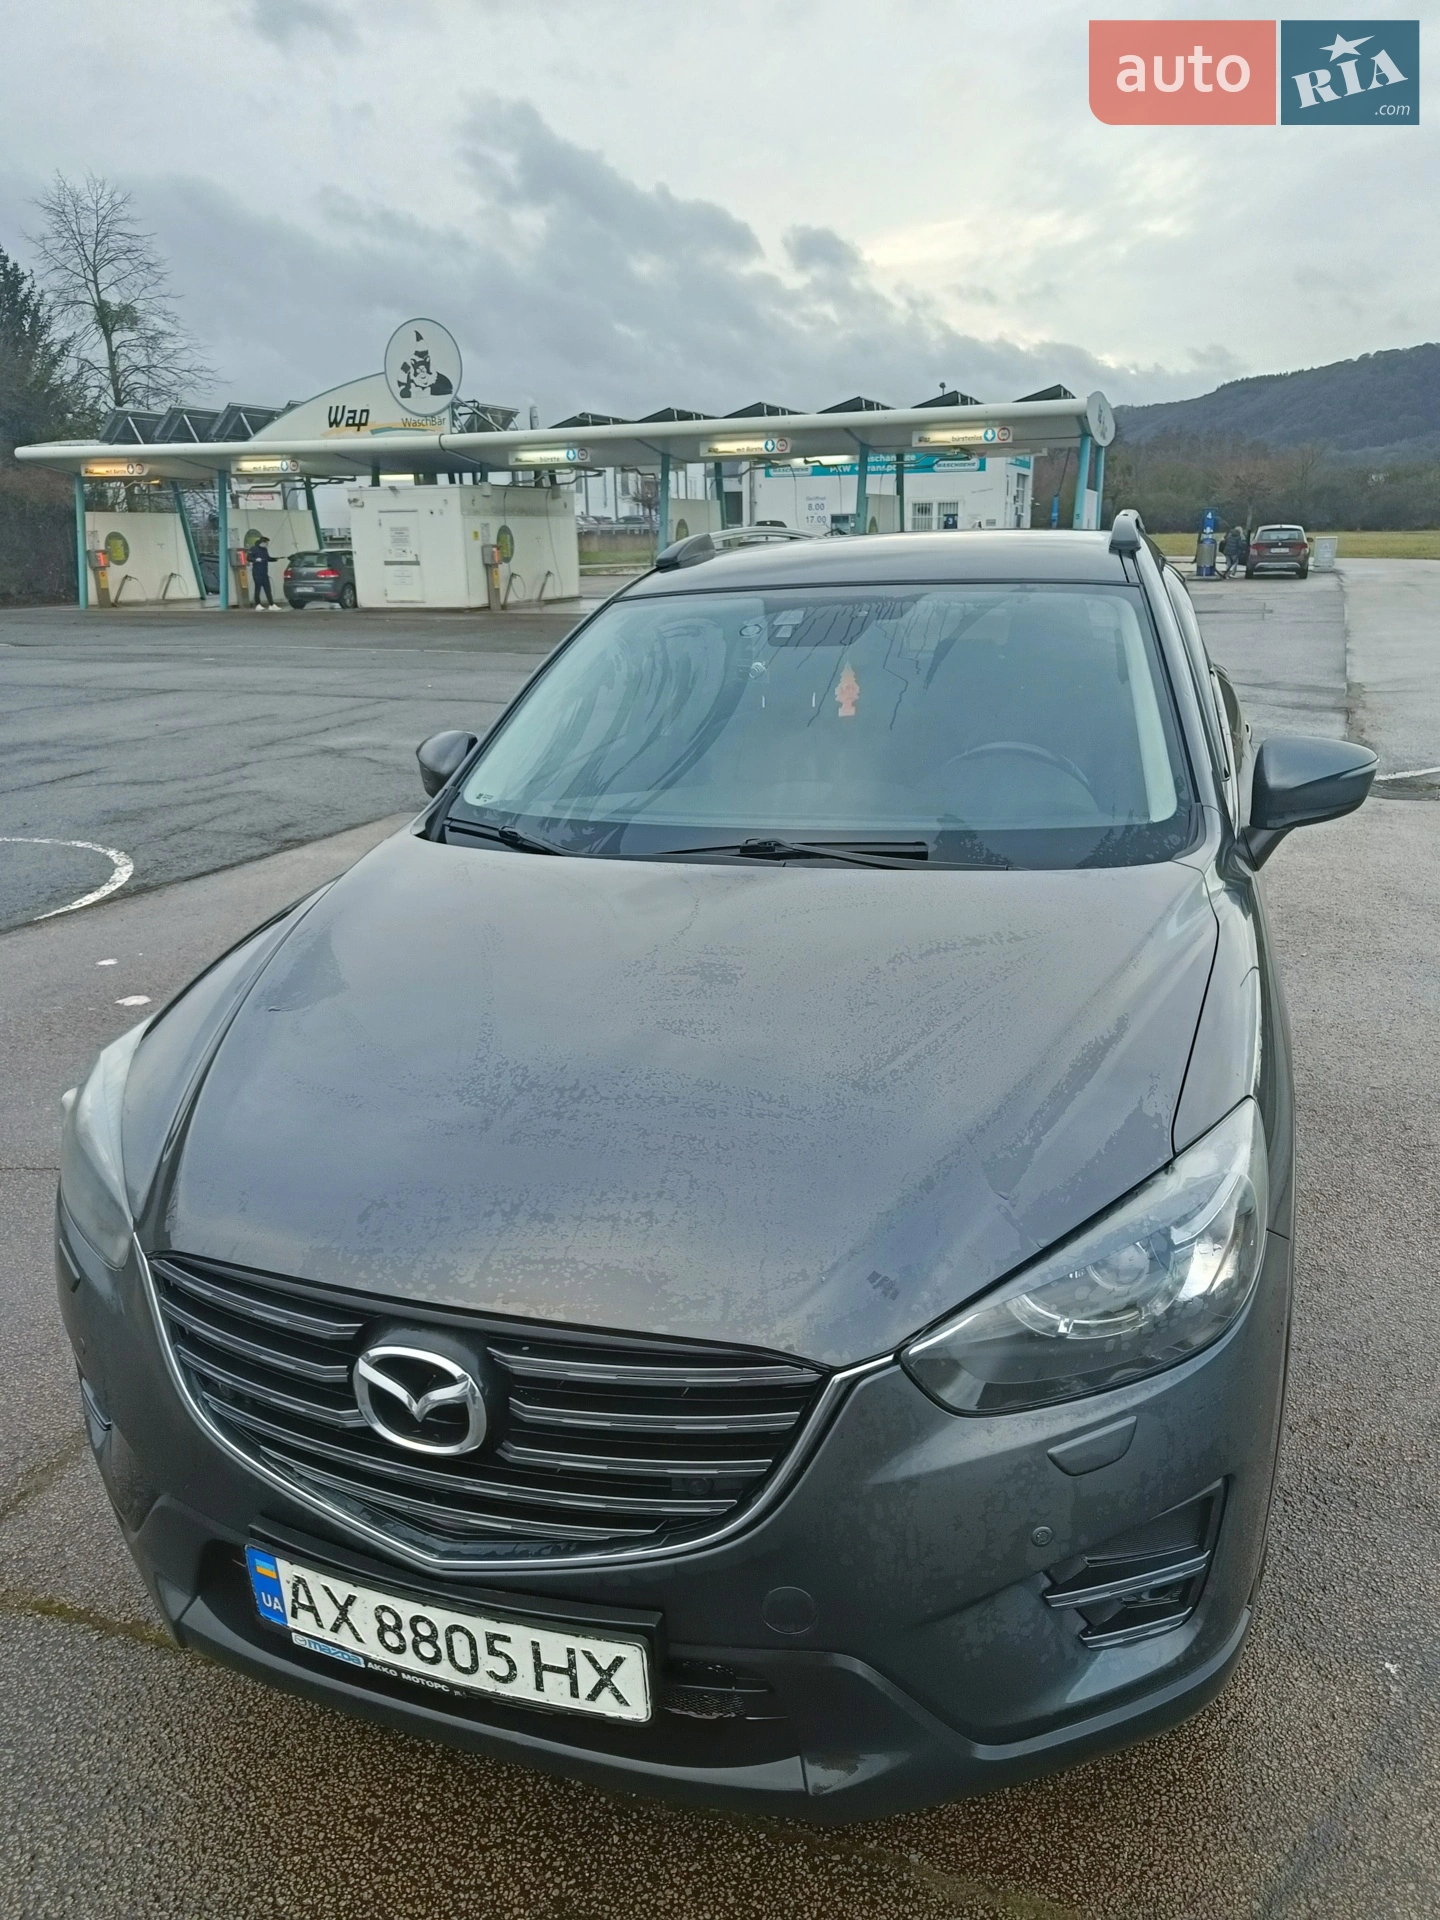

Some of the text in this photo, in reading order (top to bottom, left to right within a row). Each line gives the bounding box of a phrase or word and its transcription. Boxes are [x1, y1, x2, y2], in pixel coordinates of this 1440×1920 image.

[328, 405, 370, 432] Wap
[401, 416, 446, 428] WaschBär
[807, 503, 825, 511] 8.00
[805, 515, 827, 524] 17.00
[260, 1591, 284, 1614] UA
[290, 1573, 632, 1708] AX 8805 HX
[308, 1637, 362, 1666] mazda
